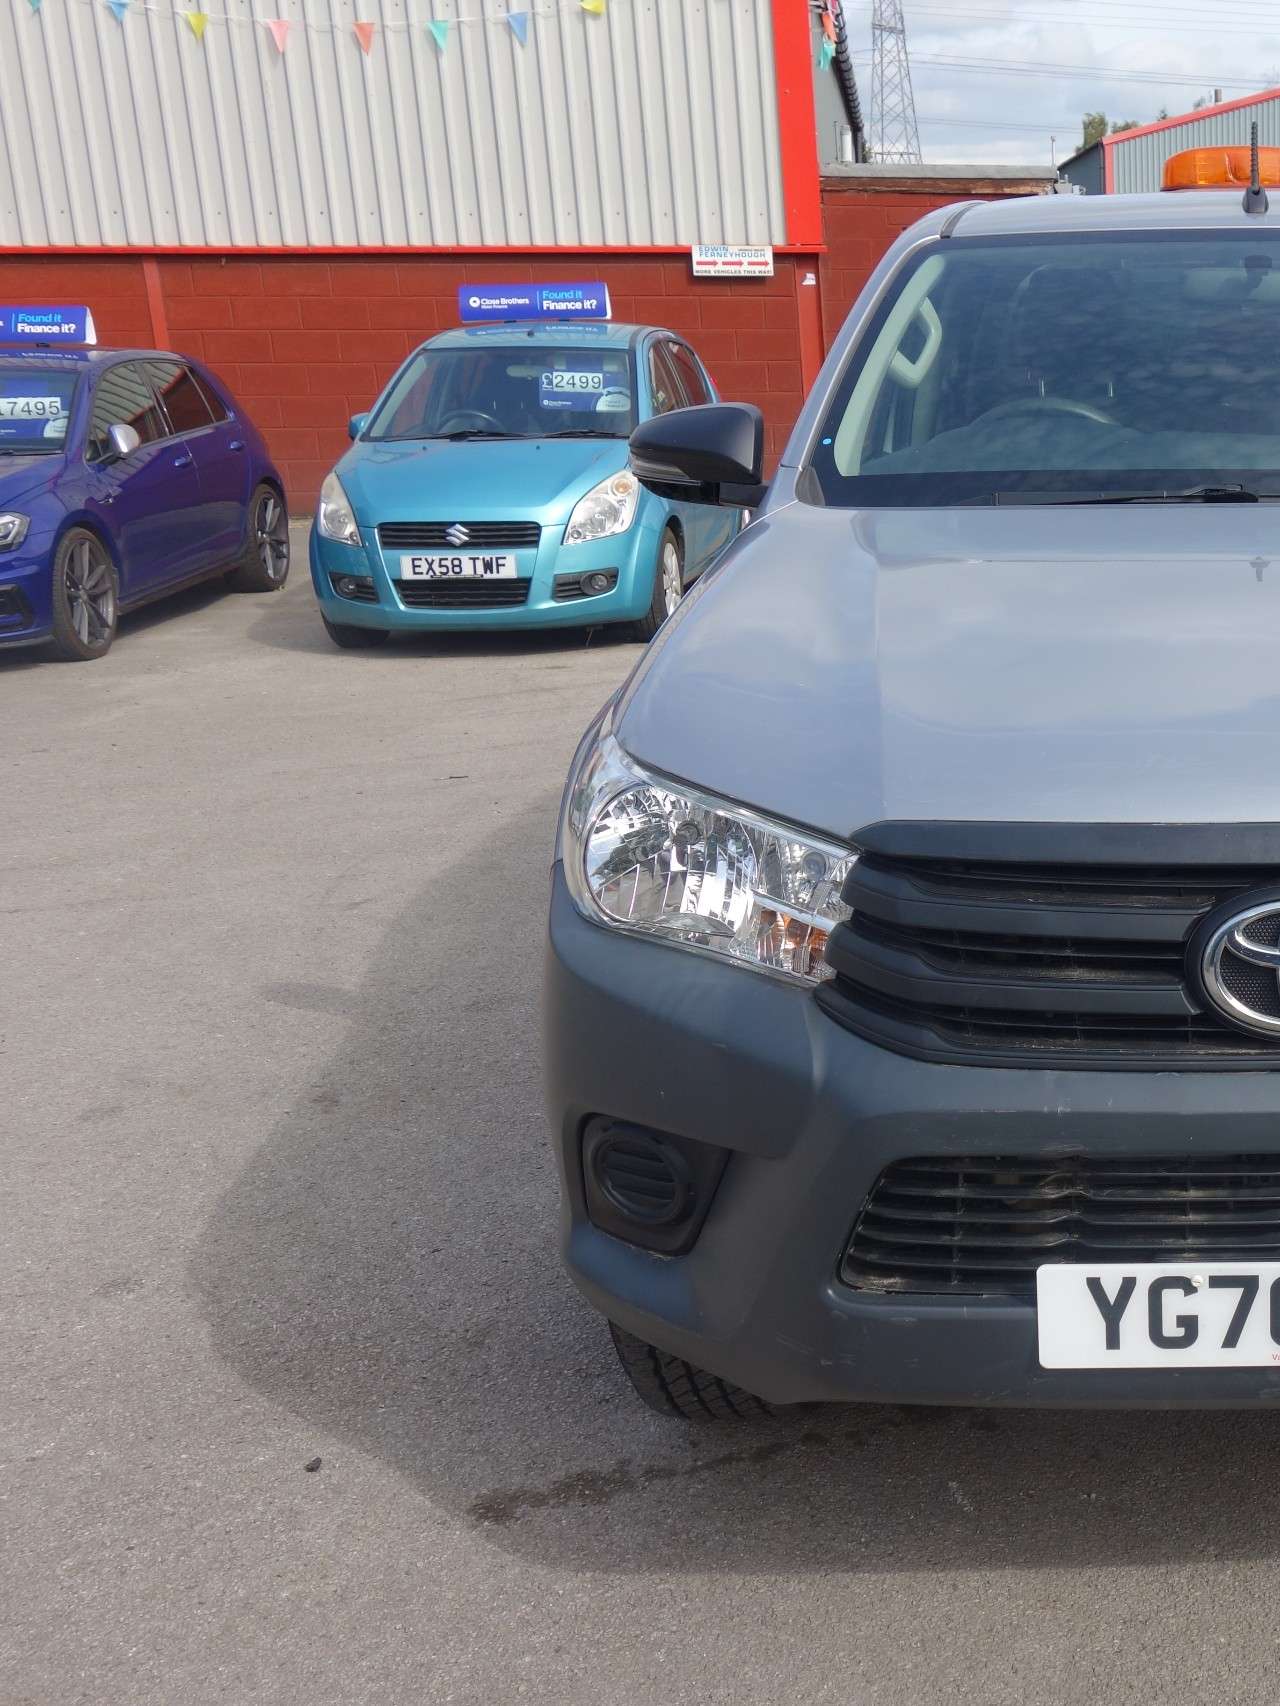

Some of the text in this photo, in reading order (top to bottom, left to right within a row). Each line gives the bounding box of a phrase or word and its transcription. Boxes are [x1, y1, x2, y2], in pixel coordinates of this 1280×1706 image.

[543, 290, 574, 299] Found
[501, 297, 530, 305] Brothers
[543, 299, 597, 311] Finance it?
[18, 313, 62, 323] Found it
[17, 323, 76, 333] Finance it?
[411, 556, 507, 576] EX58 TWF
